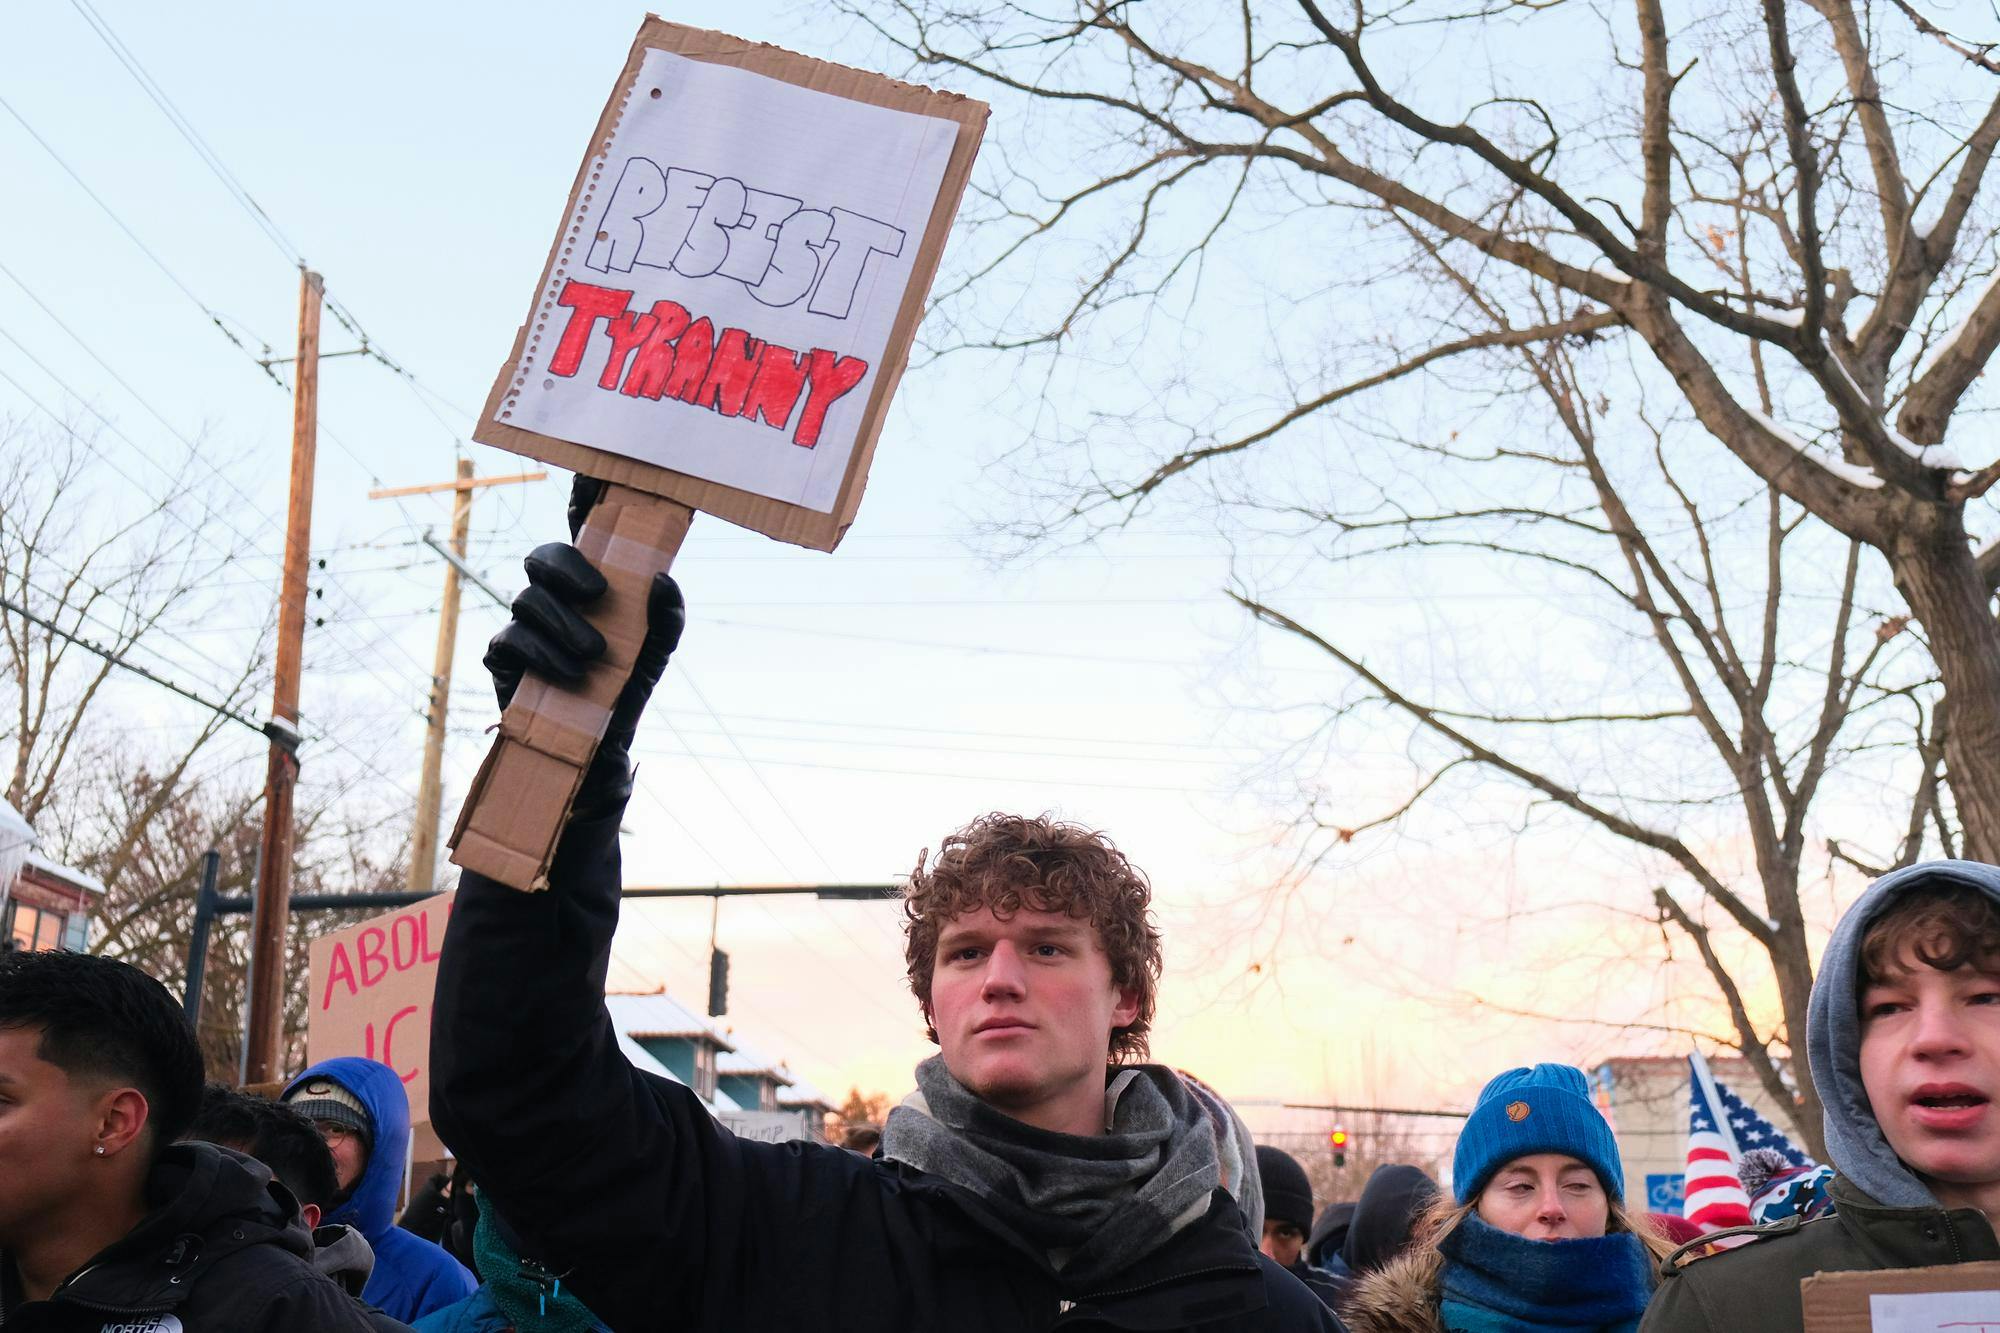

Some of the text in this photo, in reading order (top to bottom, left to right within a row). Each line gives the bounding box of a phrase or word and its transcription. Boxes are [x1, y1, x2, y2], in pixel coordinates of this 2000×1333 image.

[585, 157, 906, 319] RESIST
[548, 277, 868, 449] TYRANNY
[323, 903, 454, 1011] ABOL
[365, 1005, 436, 1084] IC
